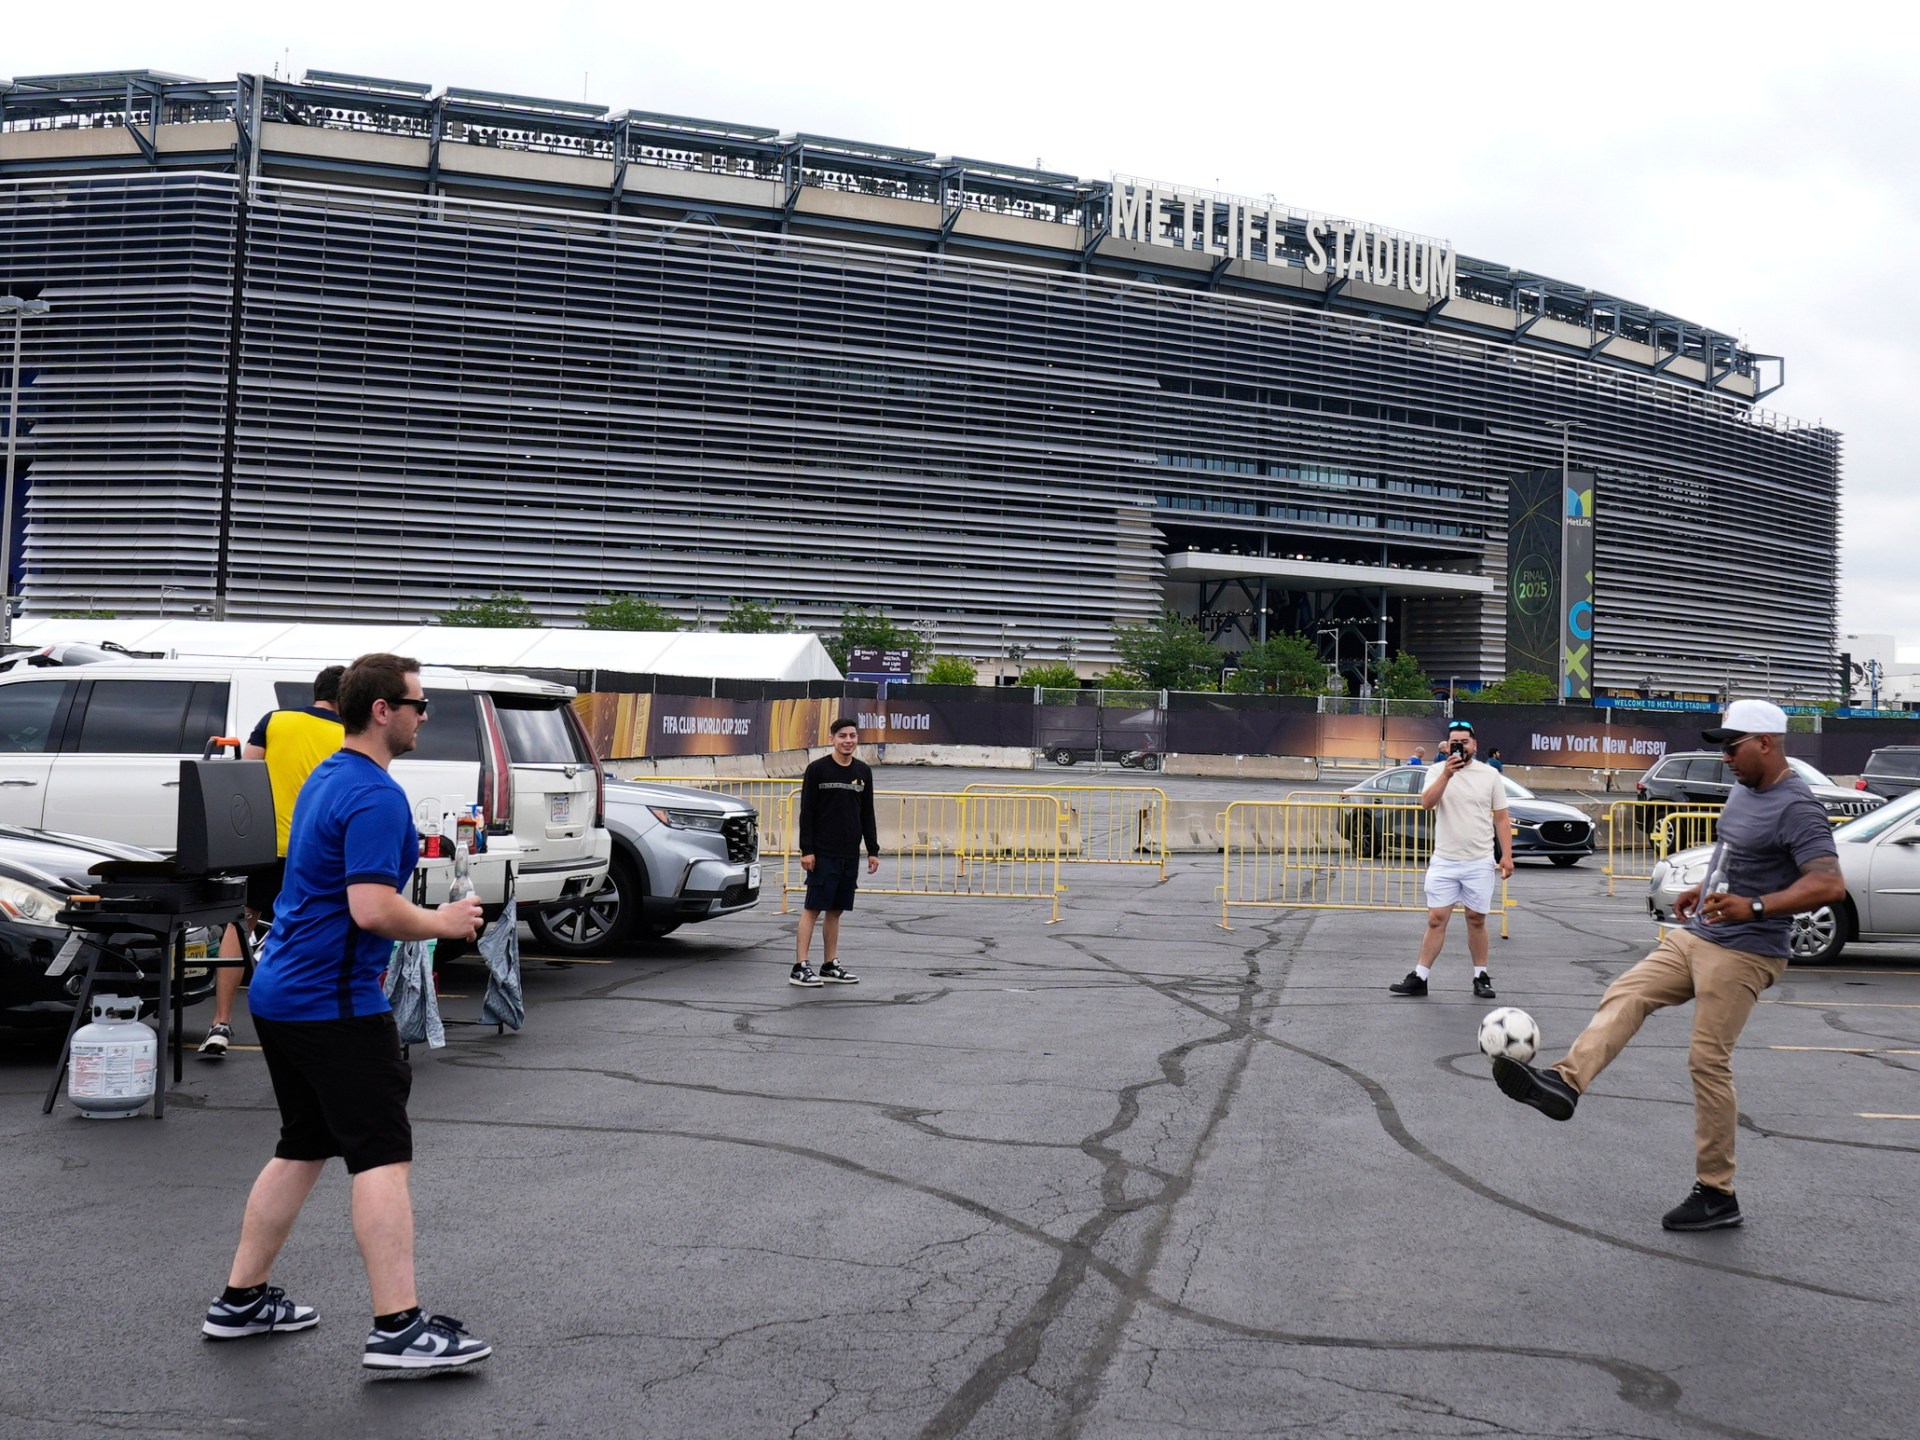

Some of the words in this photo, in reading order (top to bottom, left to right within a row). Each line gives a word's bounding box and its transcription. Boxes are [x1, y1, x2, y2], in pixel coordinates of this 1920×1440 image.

[1111, 181, 1289, 268] METLIFE
[1305, 219, 1456, 301] STADIUM
[1567, 518, 1591, 528] MetLife
[1523, 570, 1545, 581] FINAL
[1519, 581, 1548, 599] 2025
[1614, 699, 1645, 708] WELCOME
[1647, 700, 1655, 708] TO
[1656, 701, 1683, 709] METLIFE
[663, 716, 678, 734] FIFA
[678, 716, 696, 734] CLUB
[697, 717, 720, 735] WORLD
[721, 718, 734, 735] CUP
[890, 713, 930, 730] World
[1531, 733, 1562, 751] New
[1566, 734, 1599, 753] York
[1602, 736, 1627, 754] New
[1629, 738, 1667, 756] Jersey
